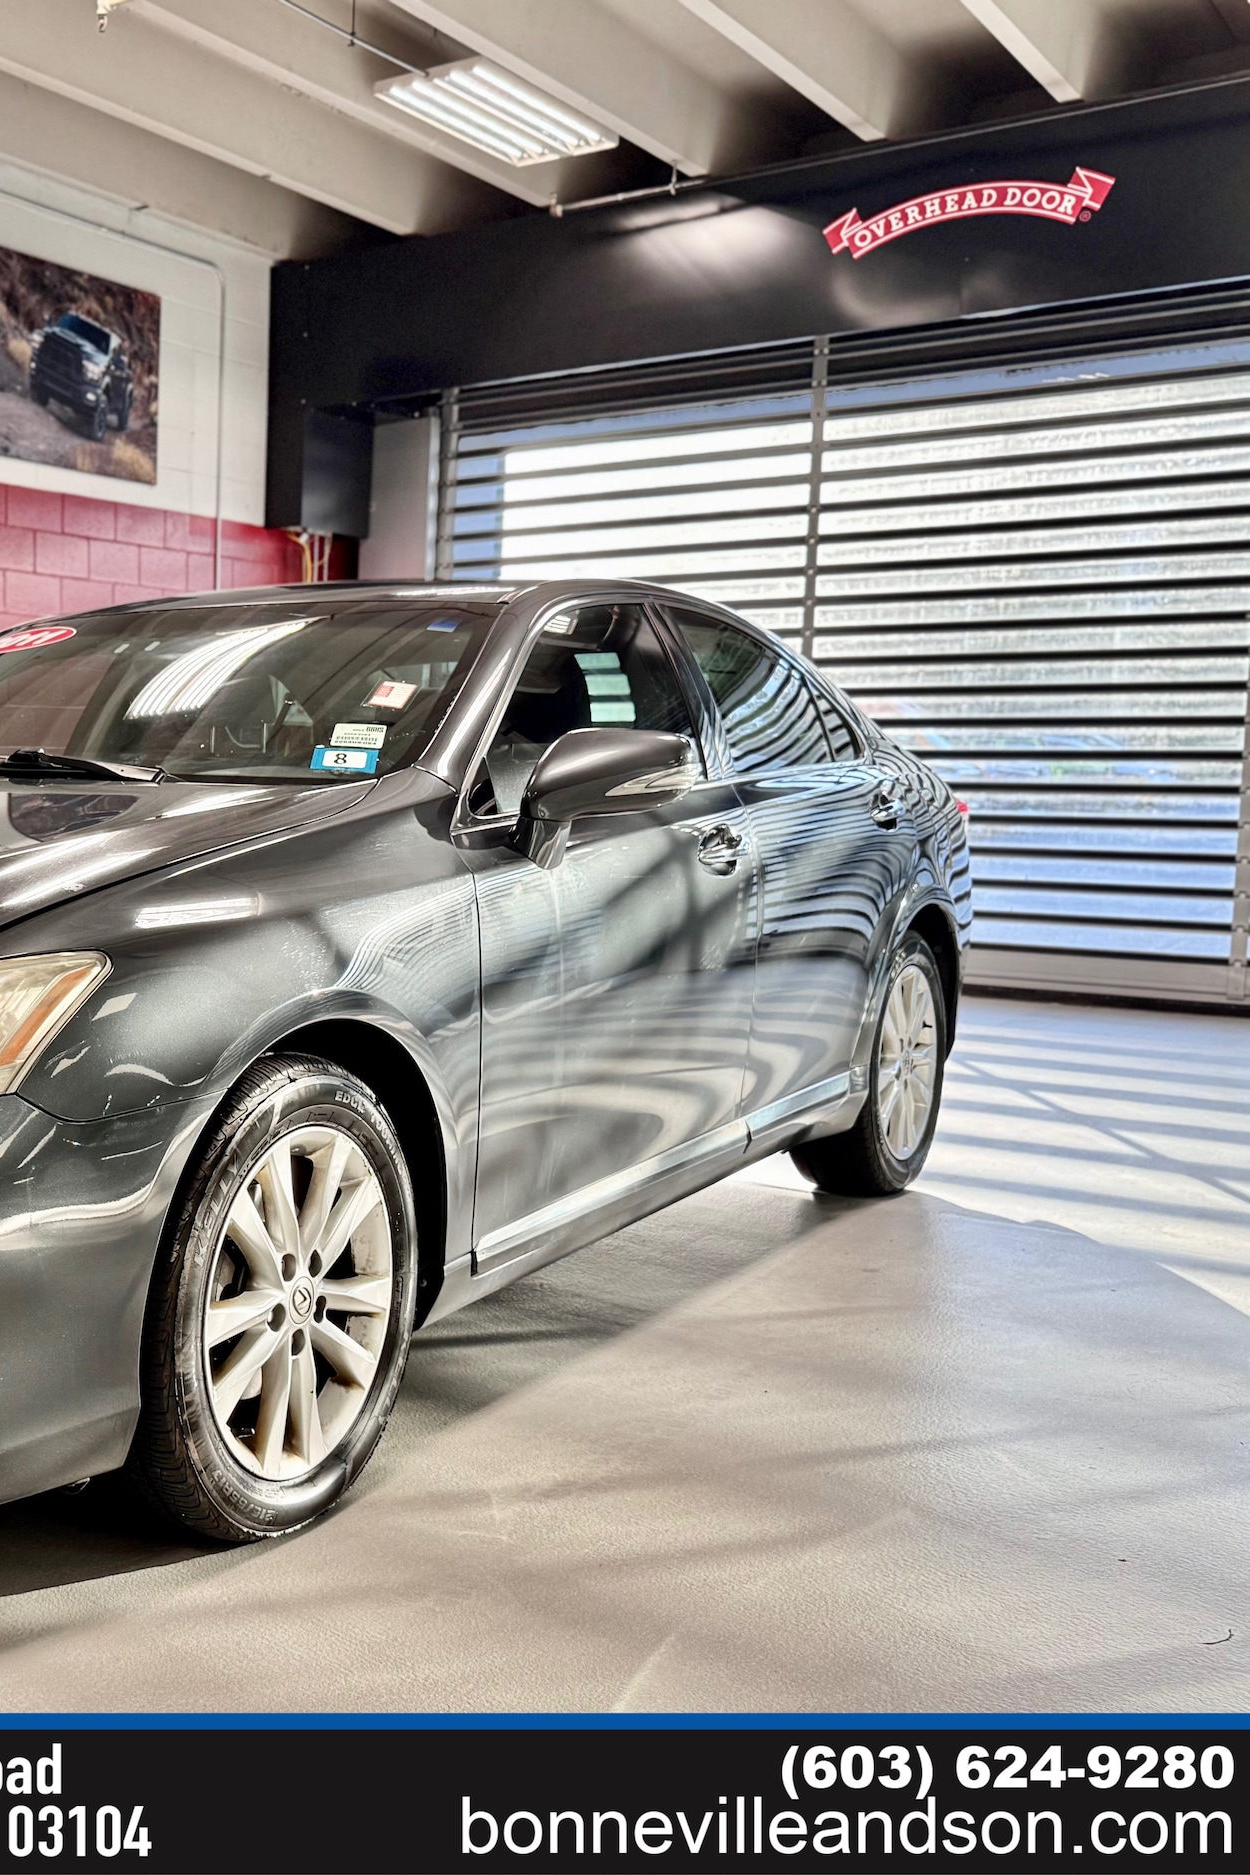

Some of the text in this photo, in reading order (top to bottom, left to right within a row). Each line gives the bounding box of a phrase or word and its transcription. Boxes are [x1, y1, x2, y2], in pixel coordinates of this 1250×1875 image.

[854, 187, 1075, 248] OVERHEAD DOOR
[333, 753, 347, 765] 8
[335, 1090, 366, 1114] EDGE
[194, 1153, 245, 1267] KELLY
